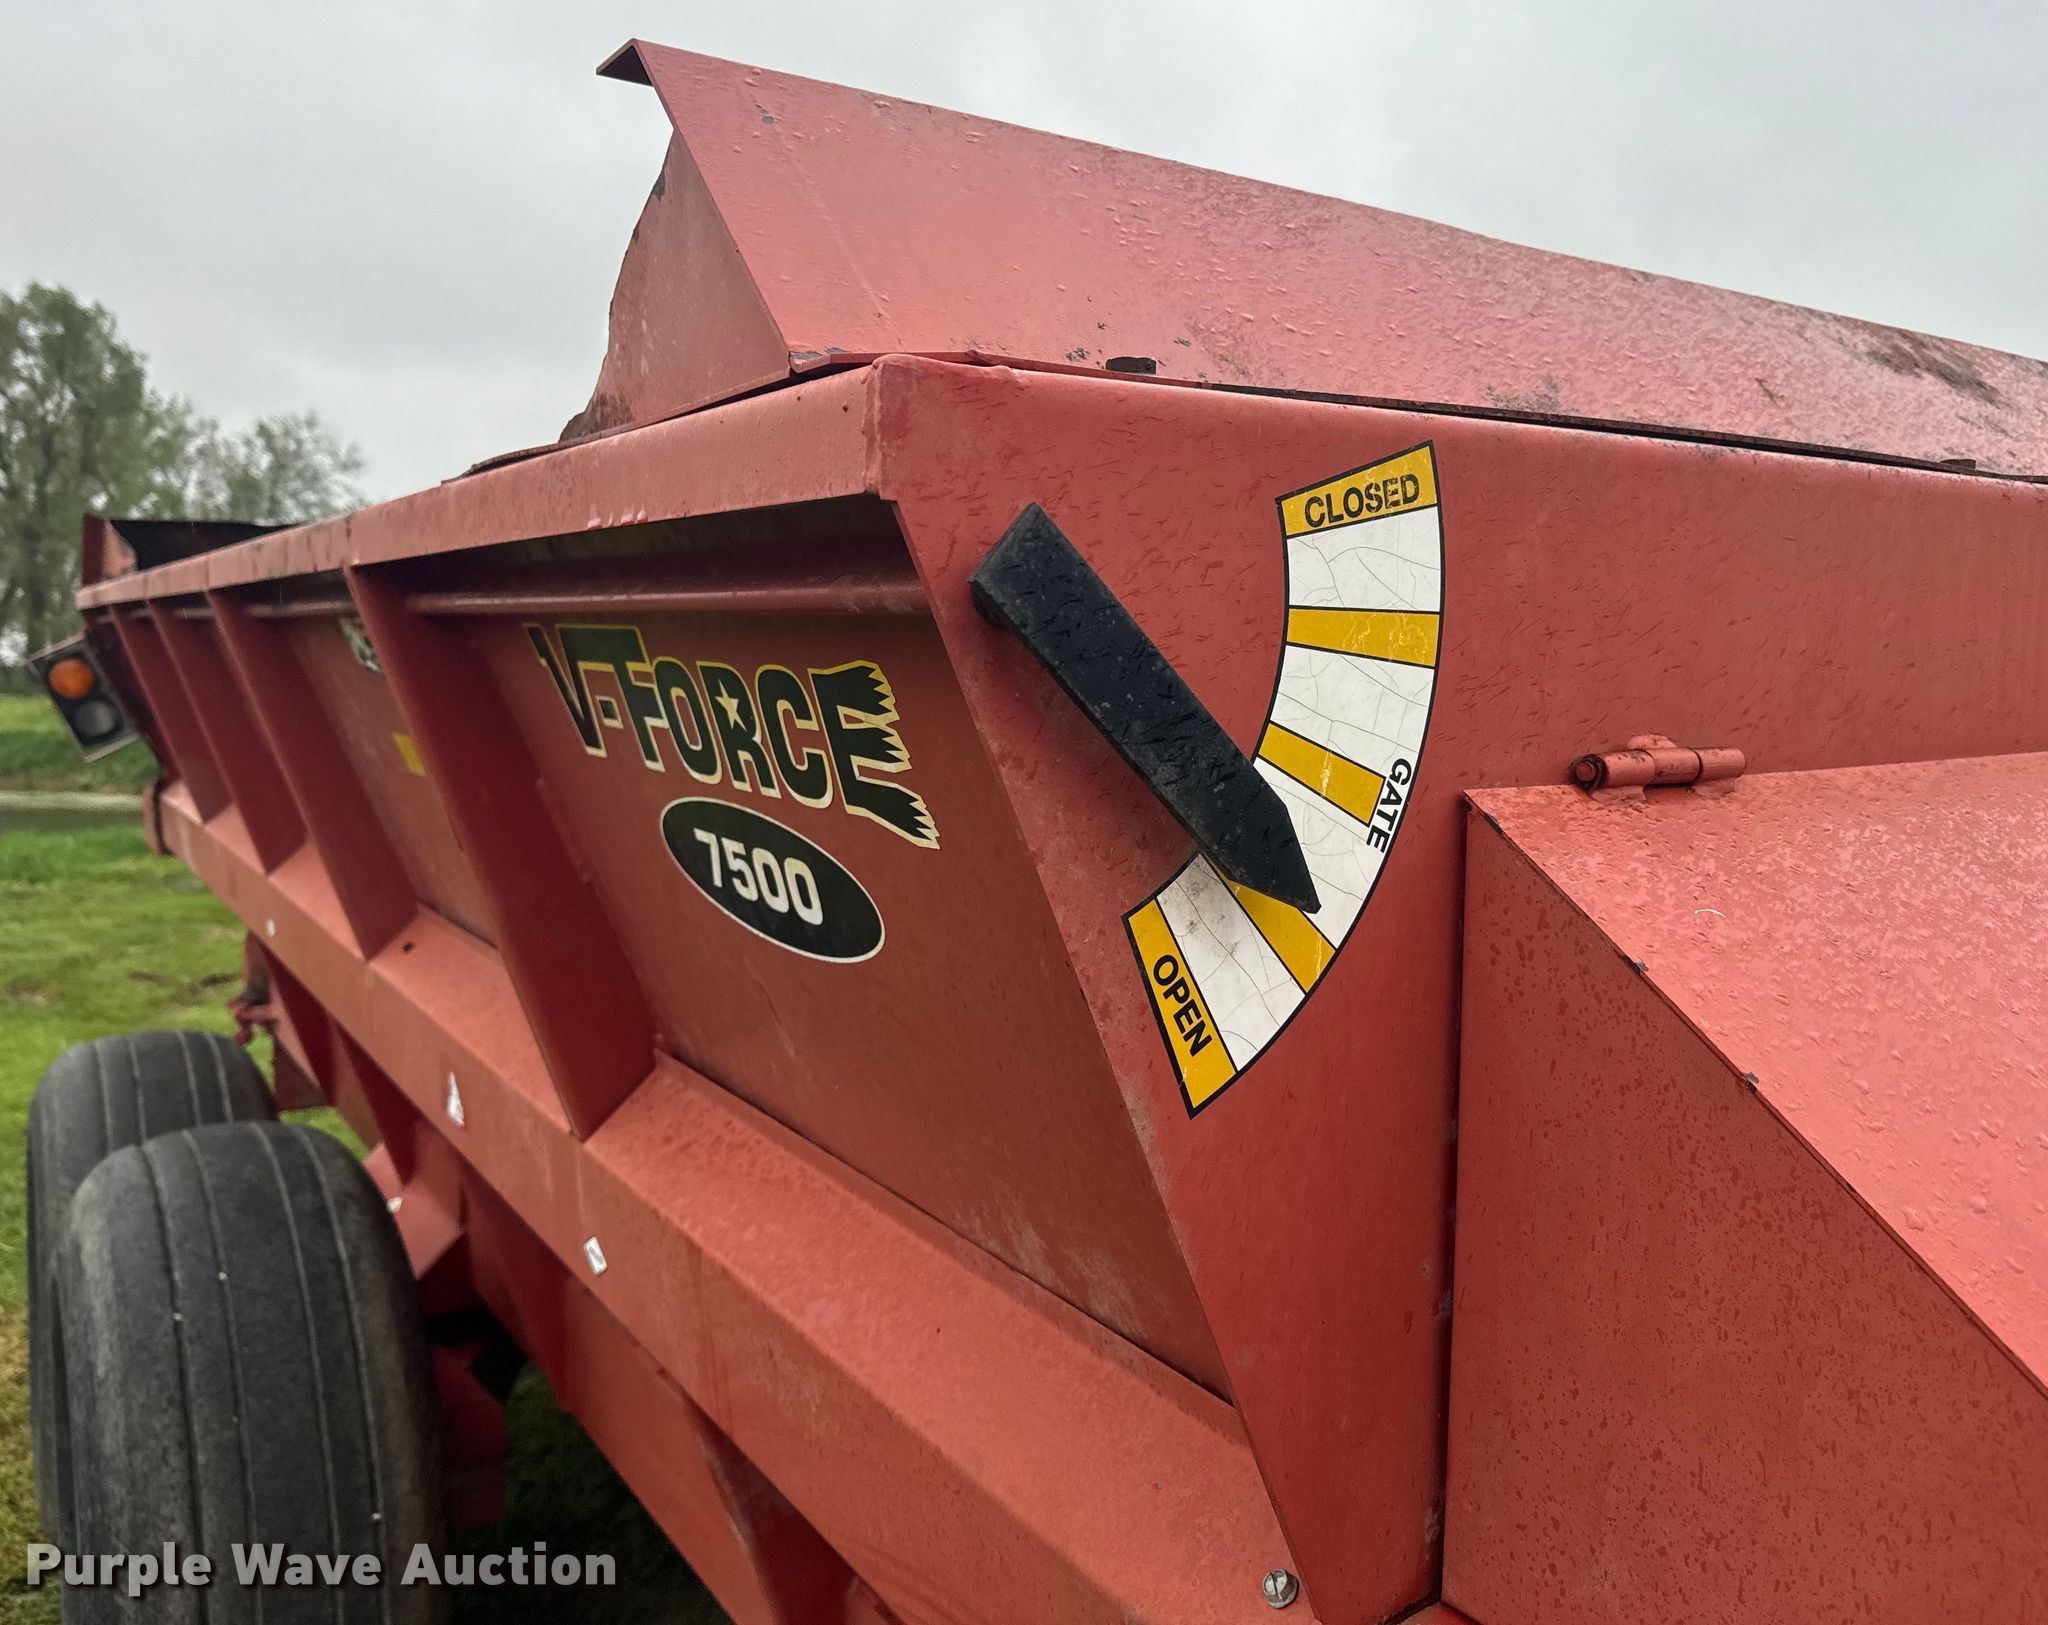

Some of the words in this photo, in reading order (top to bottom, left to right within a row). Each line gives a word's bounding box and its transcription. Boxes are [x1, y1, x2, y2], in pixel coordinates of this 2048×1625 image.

[1304, 474, 1420, 528] CLOSED
[525, 623, 940, 849] V-FORCE
[1366, 758, 1412, 852] GATE
[694, 827, 824, 926] 7500
[1153, 955, 1212, 1057] OPEN
